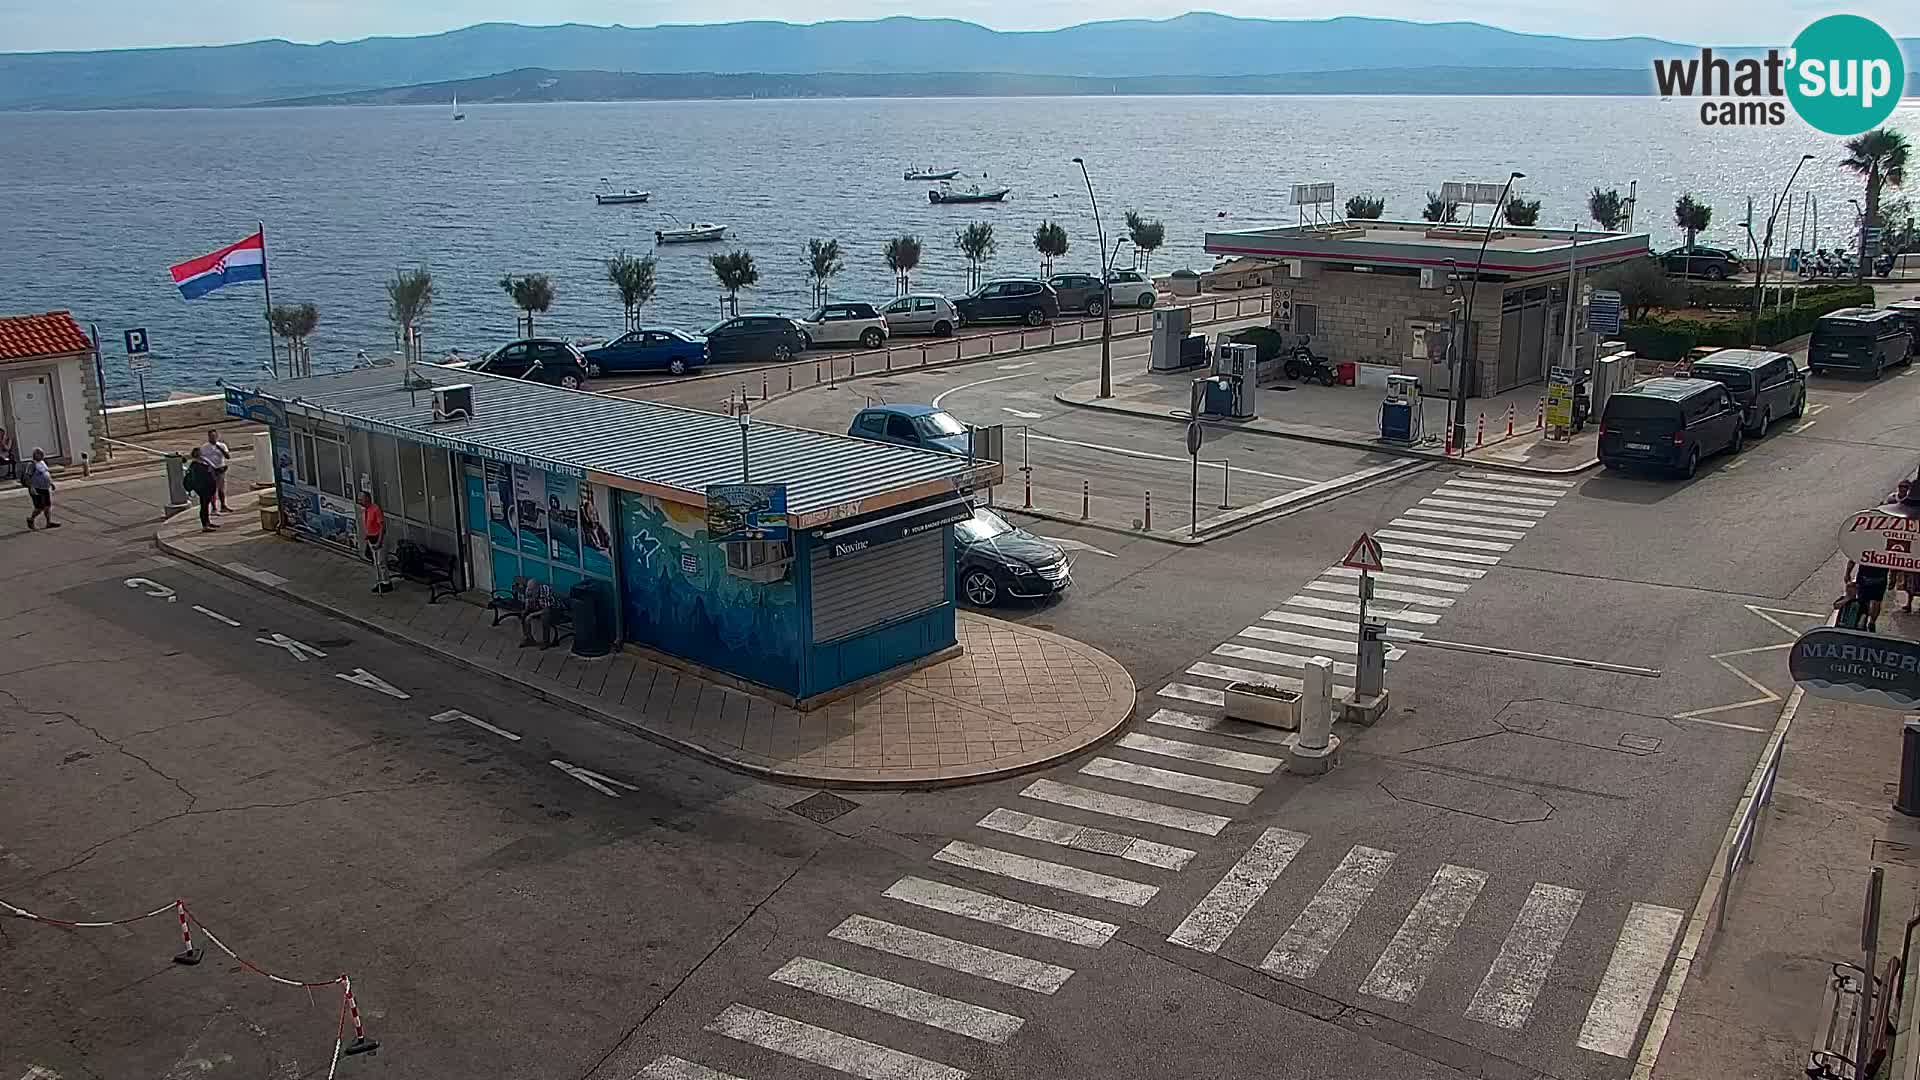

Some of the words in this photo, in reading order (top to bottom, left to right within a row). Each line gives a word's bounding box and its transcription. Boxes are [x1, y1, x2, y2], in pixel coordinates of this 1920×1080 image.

[130, 332, 142, 350] P
[494, 450, 526, 465] STATION
[528, 457, 553, 472] TICKET
[555, 463, 582, 478] OFFICE
[1849, 515, 1920, 533] PIZZE
[1830, 663, 1866, 676] caffe
[1872, 667, 1899, 680] bar
